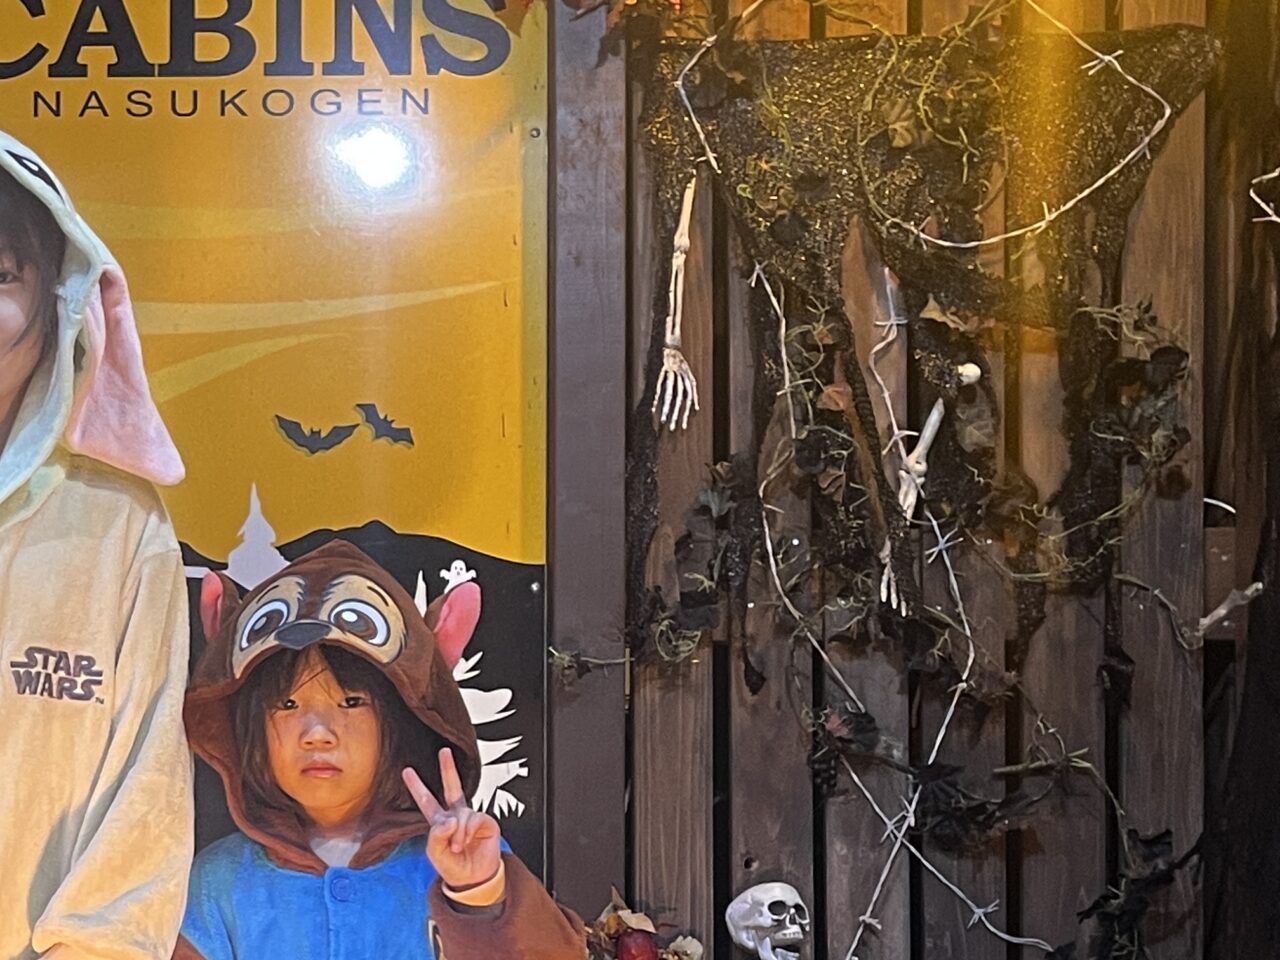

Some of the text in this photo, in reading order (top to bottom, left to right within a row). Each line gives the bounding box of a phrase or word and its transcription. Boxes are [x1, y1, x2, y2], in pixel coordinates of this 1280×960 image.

[33, 88, 429, 118] NASUKOGEN
[10, 646, 103, 677] STAR
[11, 669, 103, 701] WARS
